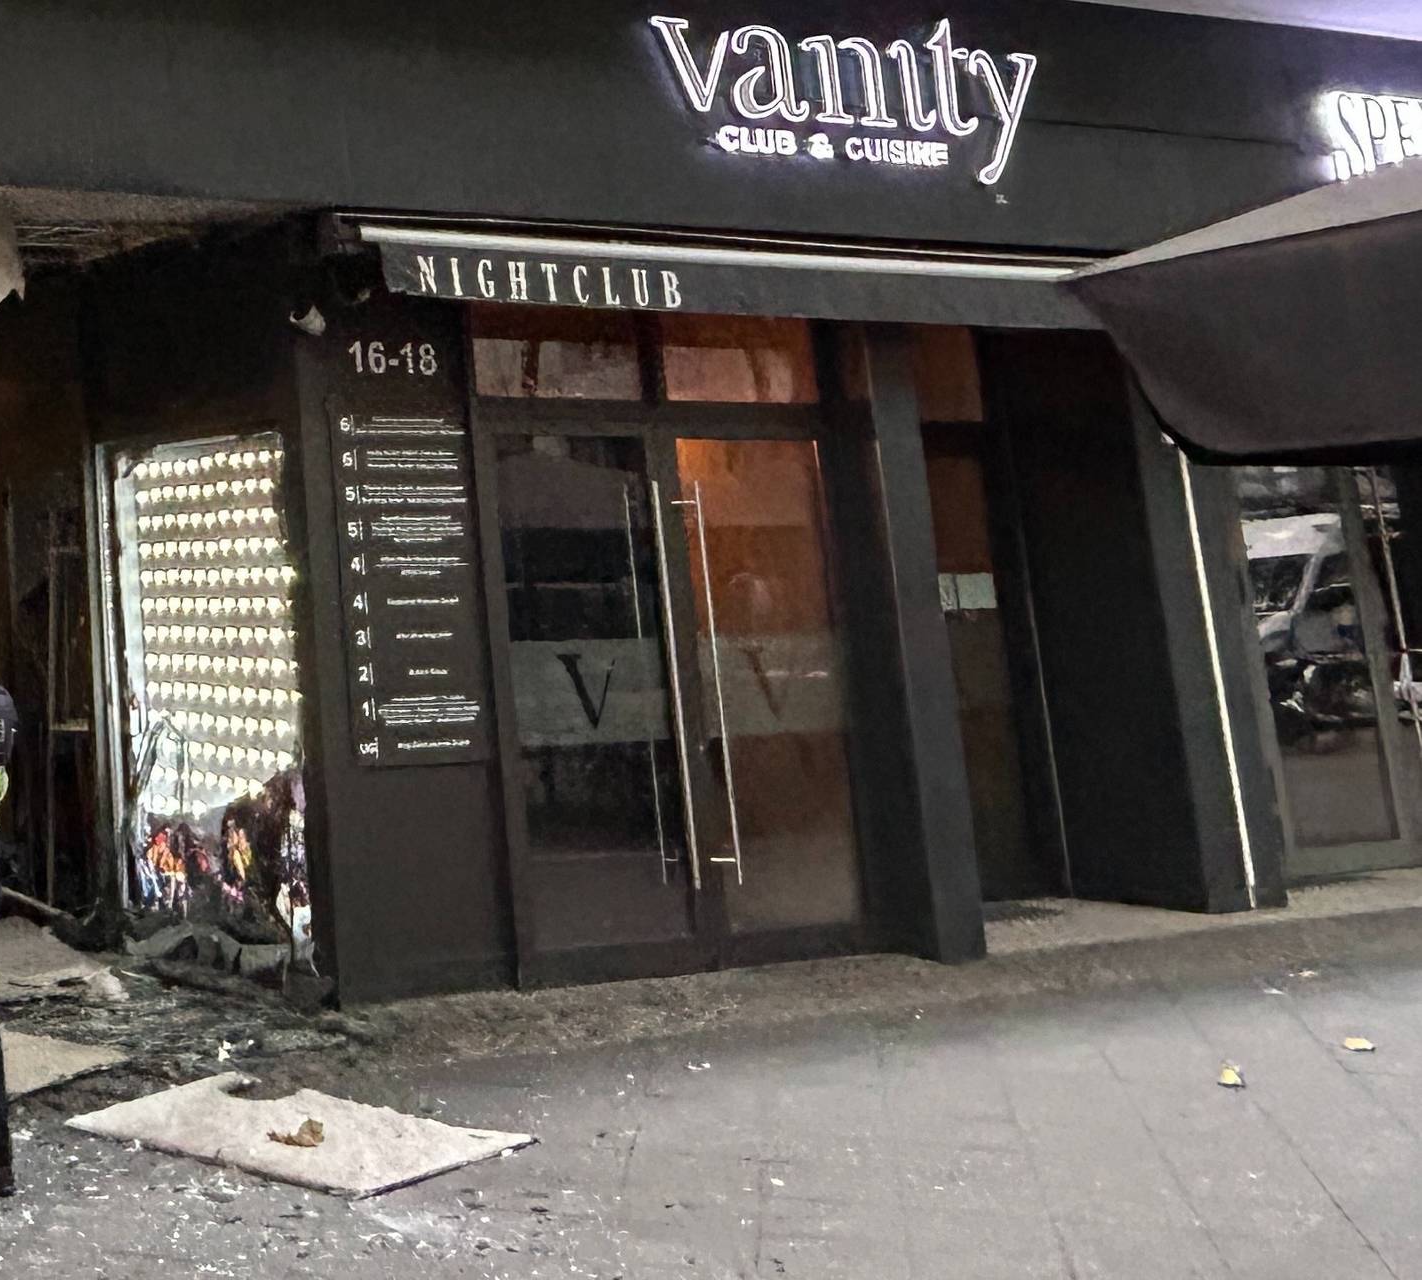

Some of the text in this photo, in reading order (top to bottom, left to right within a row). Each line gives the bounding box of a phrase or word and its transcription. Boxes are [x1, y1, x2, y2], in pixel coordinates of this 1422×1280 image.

[1331, 92, 1422, 181] SPE
[718, 126, 949, 167] CLUB & CUISINE
[416, 255, 683, 309] NIGHTCLUB
[348, 340, 438, 376] 16-18
[339, 417, 351, 432] 6
[345, 486, 356, 502] 5
[347, 522, 358, 538] 5
[352, 594, 363, 610] 4
[355, 630, 367, 646] 3
[358, 666, 369, 682] 2
[556, 652, 616, 729] V
[362, 701, 370, 717] 1
